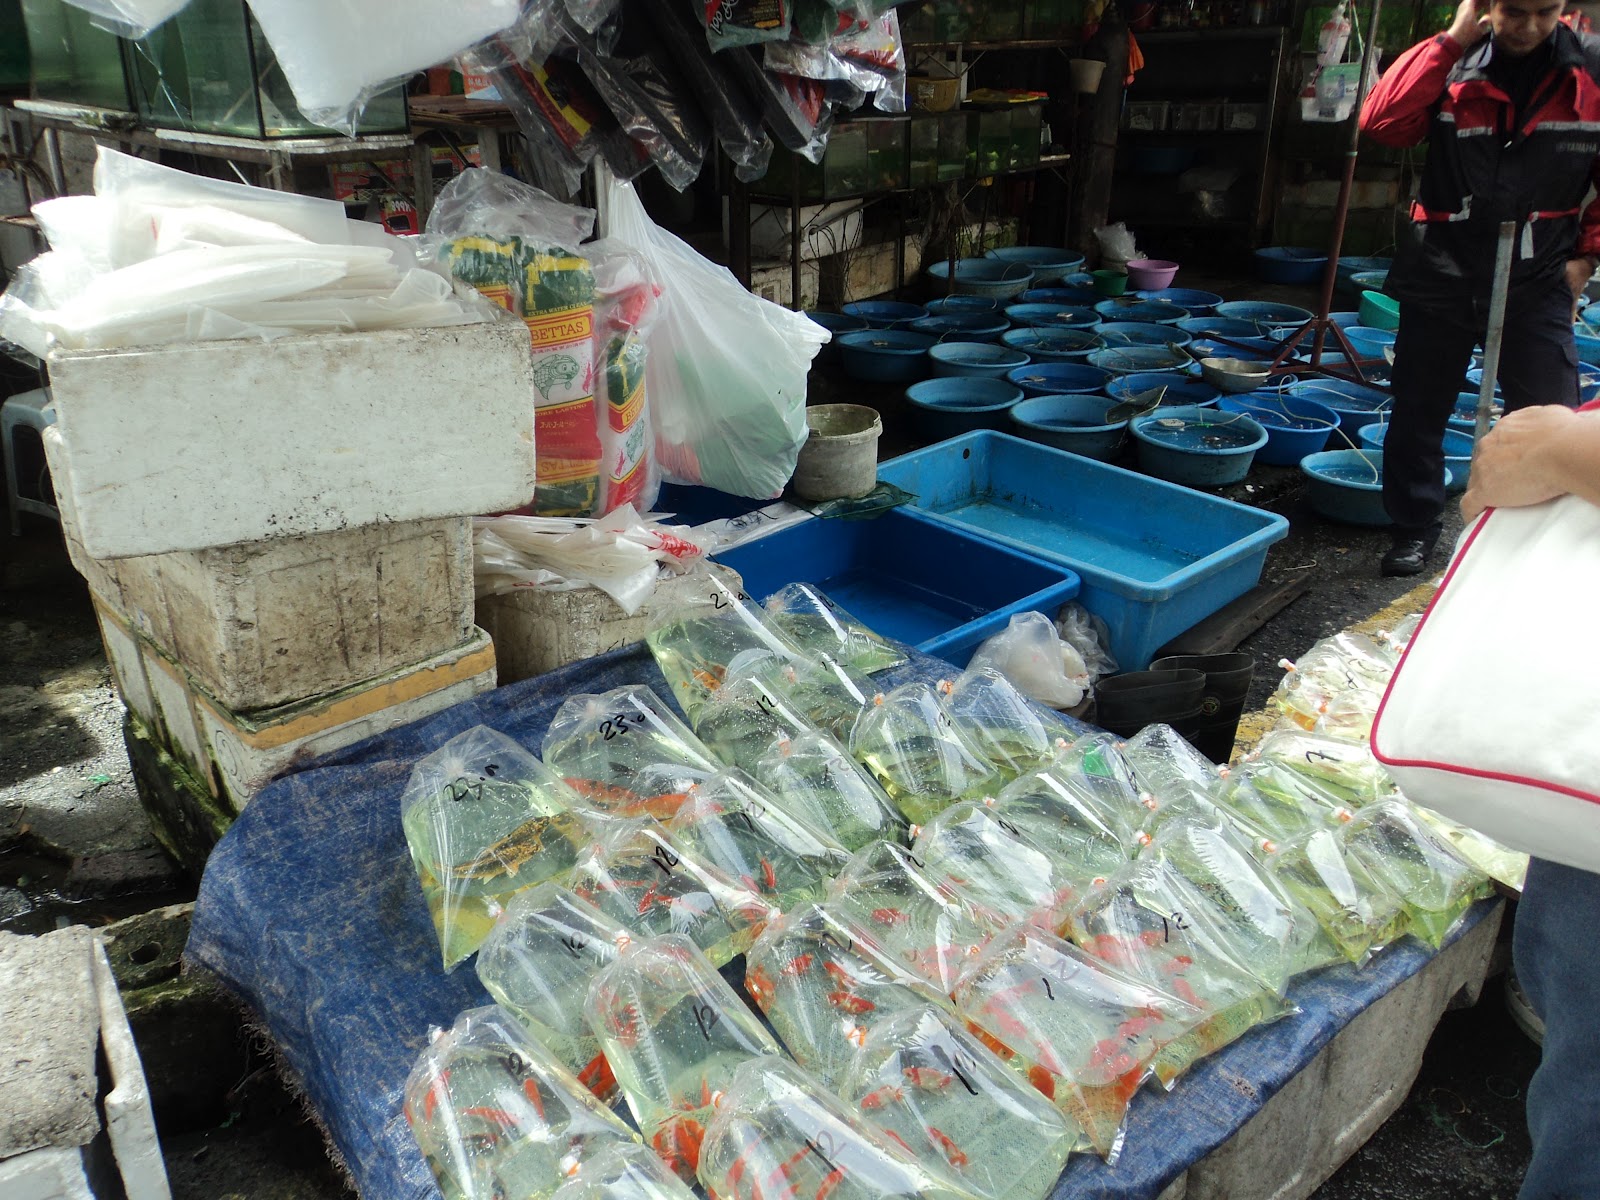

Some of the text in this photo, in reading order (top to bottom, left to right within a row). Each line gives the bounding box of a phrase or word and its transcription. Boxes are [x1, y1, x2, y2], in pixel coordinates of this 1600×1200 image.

[527, 308, 548, 317] EXTRA
[548, 305, 569, 314] WATER
[530, 321, 584, 341] BETTAS
[555, 403, 588, 414] LASTING
[756, 694, 777, 716] 12
[651, 845, 679, 876] 12
[1162, 911, 1193, 944] 12
[561, 931, 591, 960] 12
[1041, 958, 1082, 1001] 12
[692, 1004, 722, 1042] 12
[497, 1052, 533, 1087] 12
[804, 1130, 848, 1172] 12
